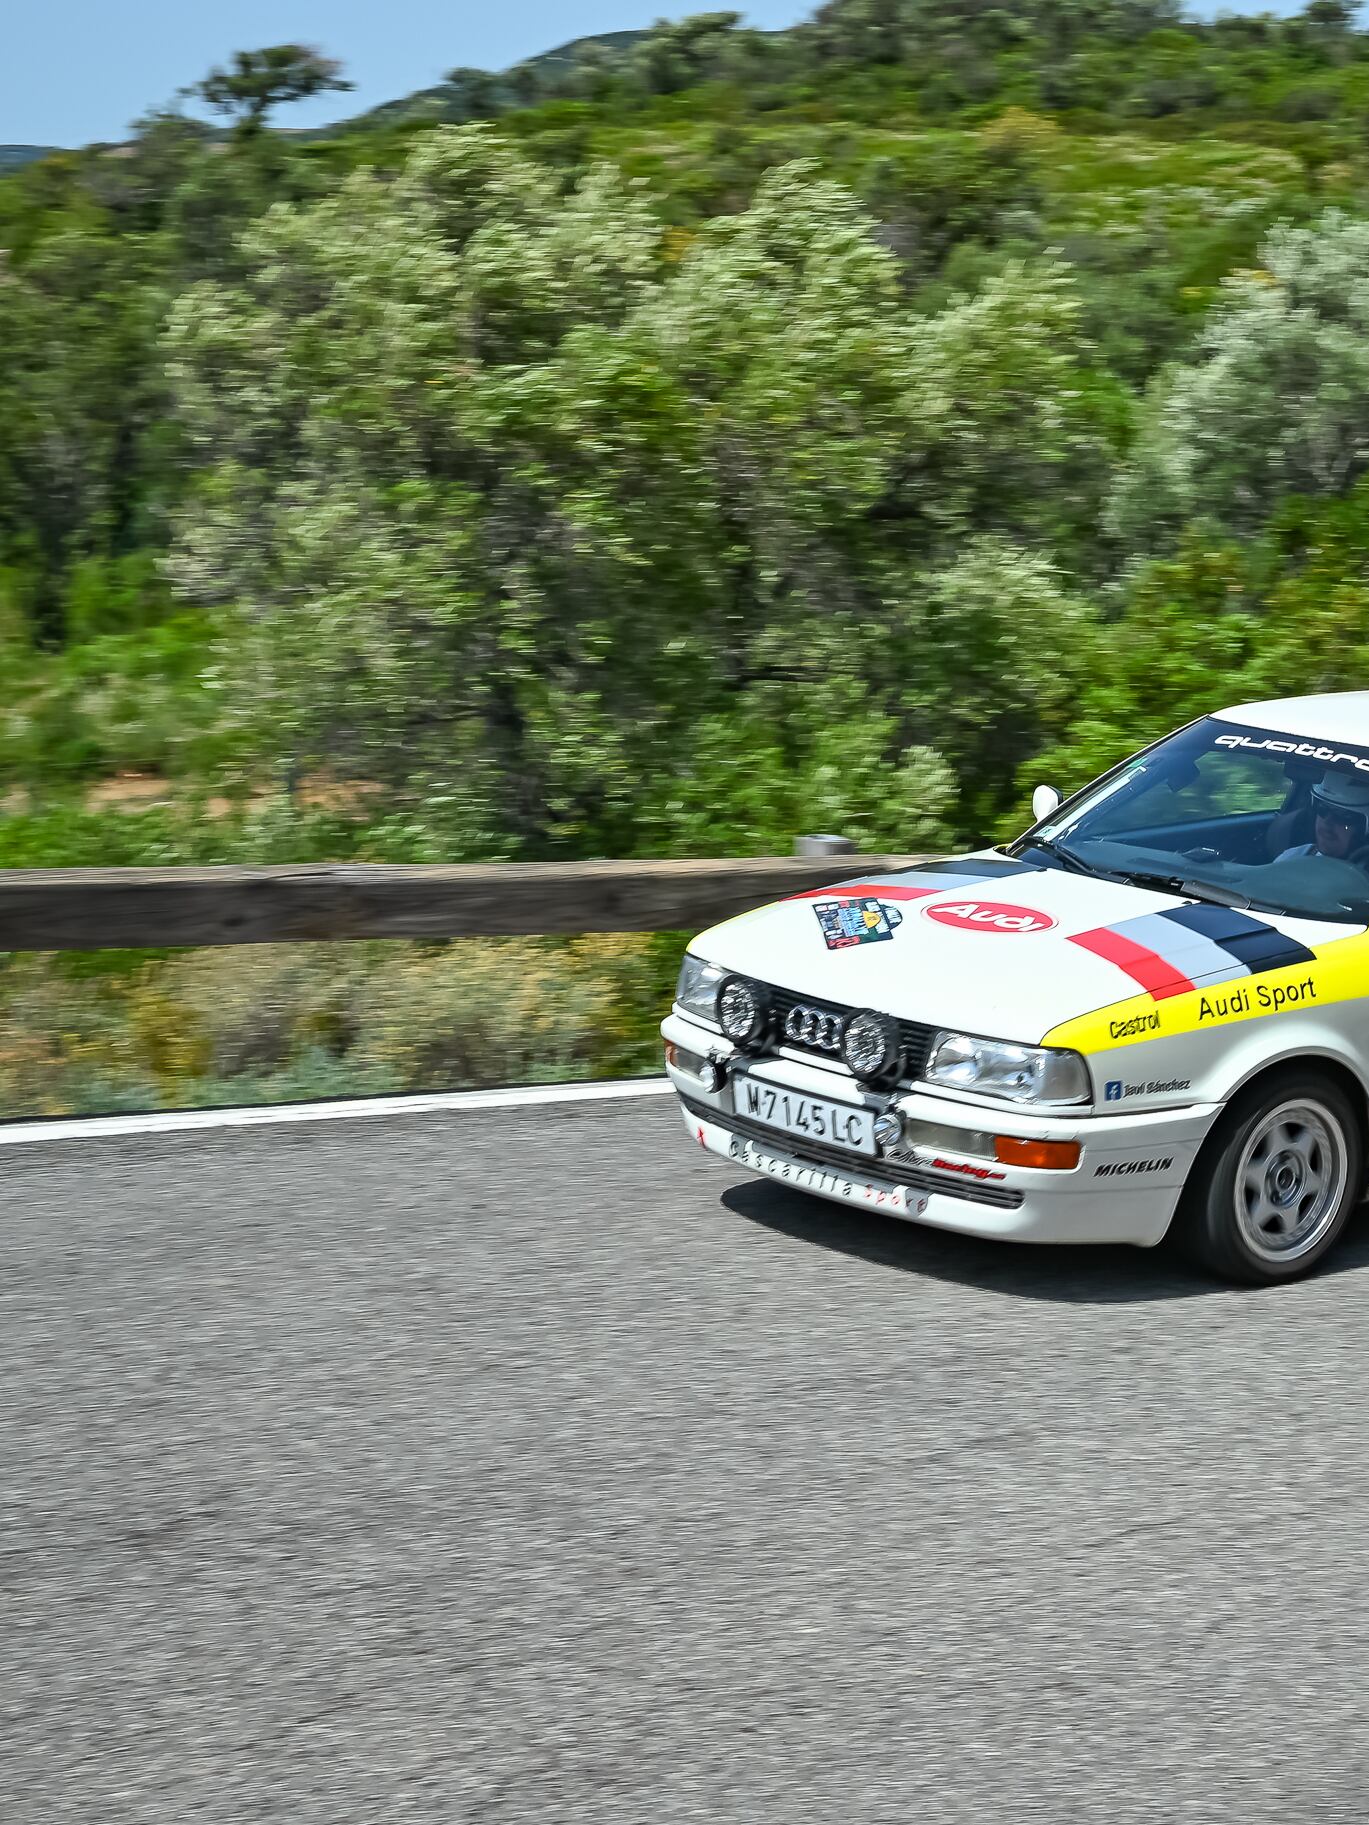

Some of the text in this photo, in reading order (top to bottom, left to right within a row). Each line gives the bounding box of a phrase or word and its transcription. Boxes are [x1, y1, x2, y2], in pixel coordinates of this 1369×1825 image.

[931, 904, 1045, 932] Audi
[1199, 977, 1317, 1021] Audi Sport
[1109, 1010, 1161, 1039] Castrol
[1146, 1079, 1191, 1094] Sánchez
[1093, 1157, 1175, 1178] MICHELIN
